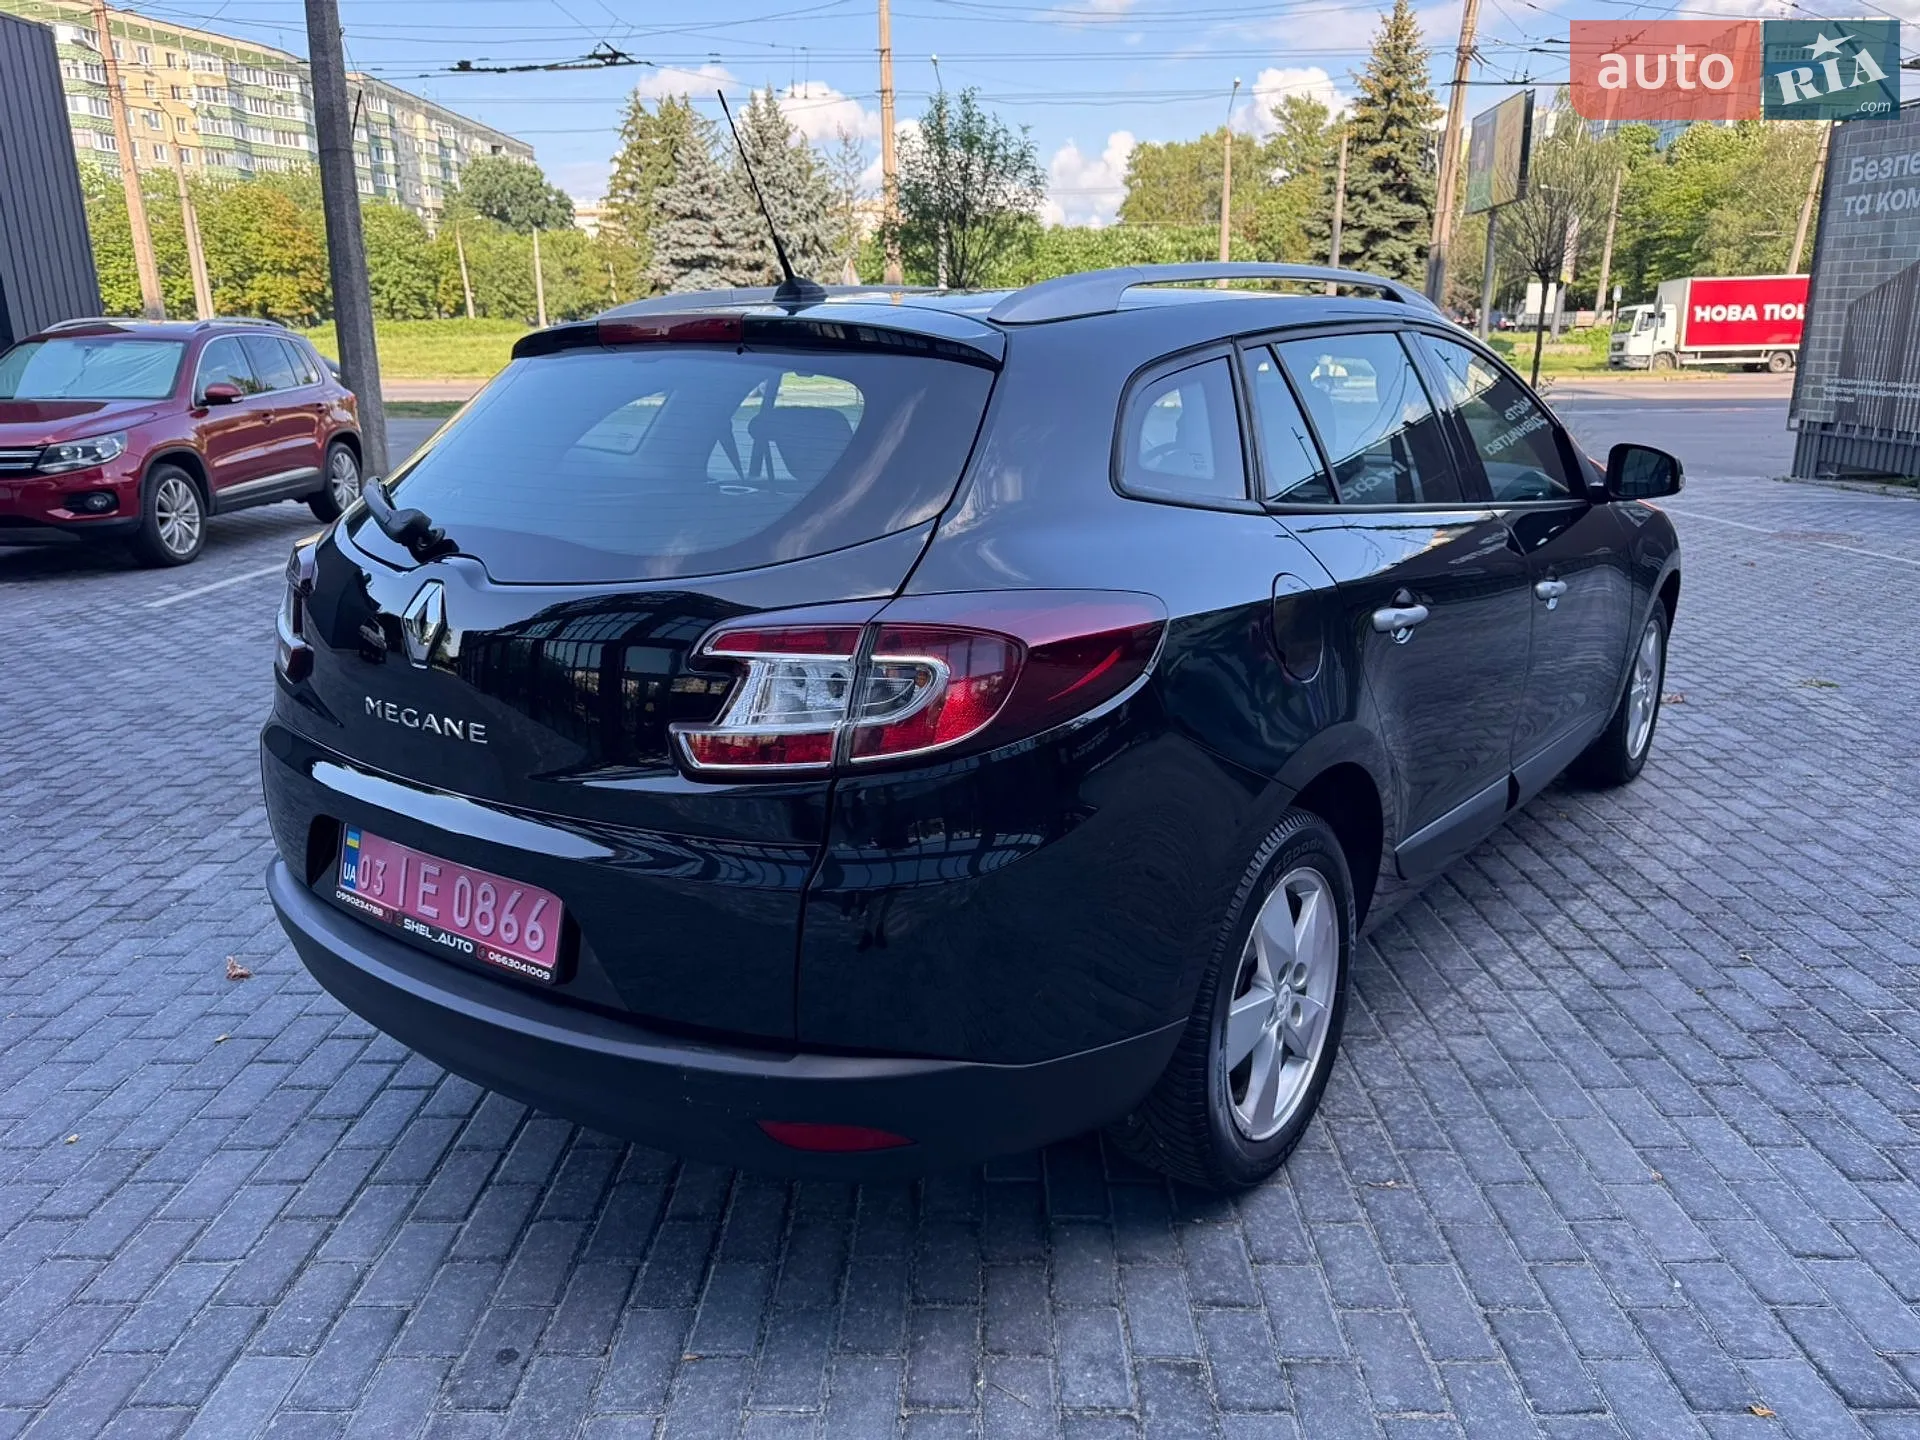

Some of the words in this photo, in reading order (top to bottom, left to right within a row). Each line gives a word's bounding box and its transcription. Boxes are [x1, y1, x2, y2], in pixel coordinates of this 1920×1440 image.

[1848, 152, 1920, 184] Безпе
[1844, 194, 1872, 216] та
[1876, 187, 1920, 213] ком
[1694, 304, 1758, 323] НОВА
[365, 696, 488, 744] MEGANE
[343, 861, 356, 883] UA
[360, 855, 387, 896] 03
[453, 875, 549, 952] 0866
[403, 918, 473, 953] SHEL_AUTO
